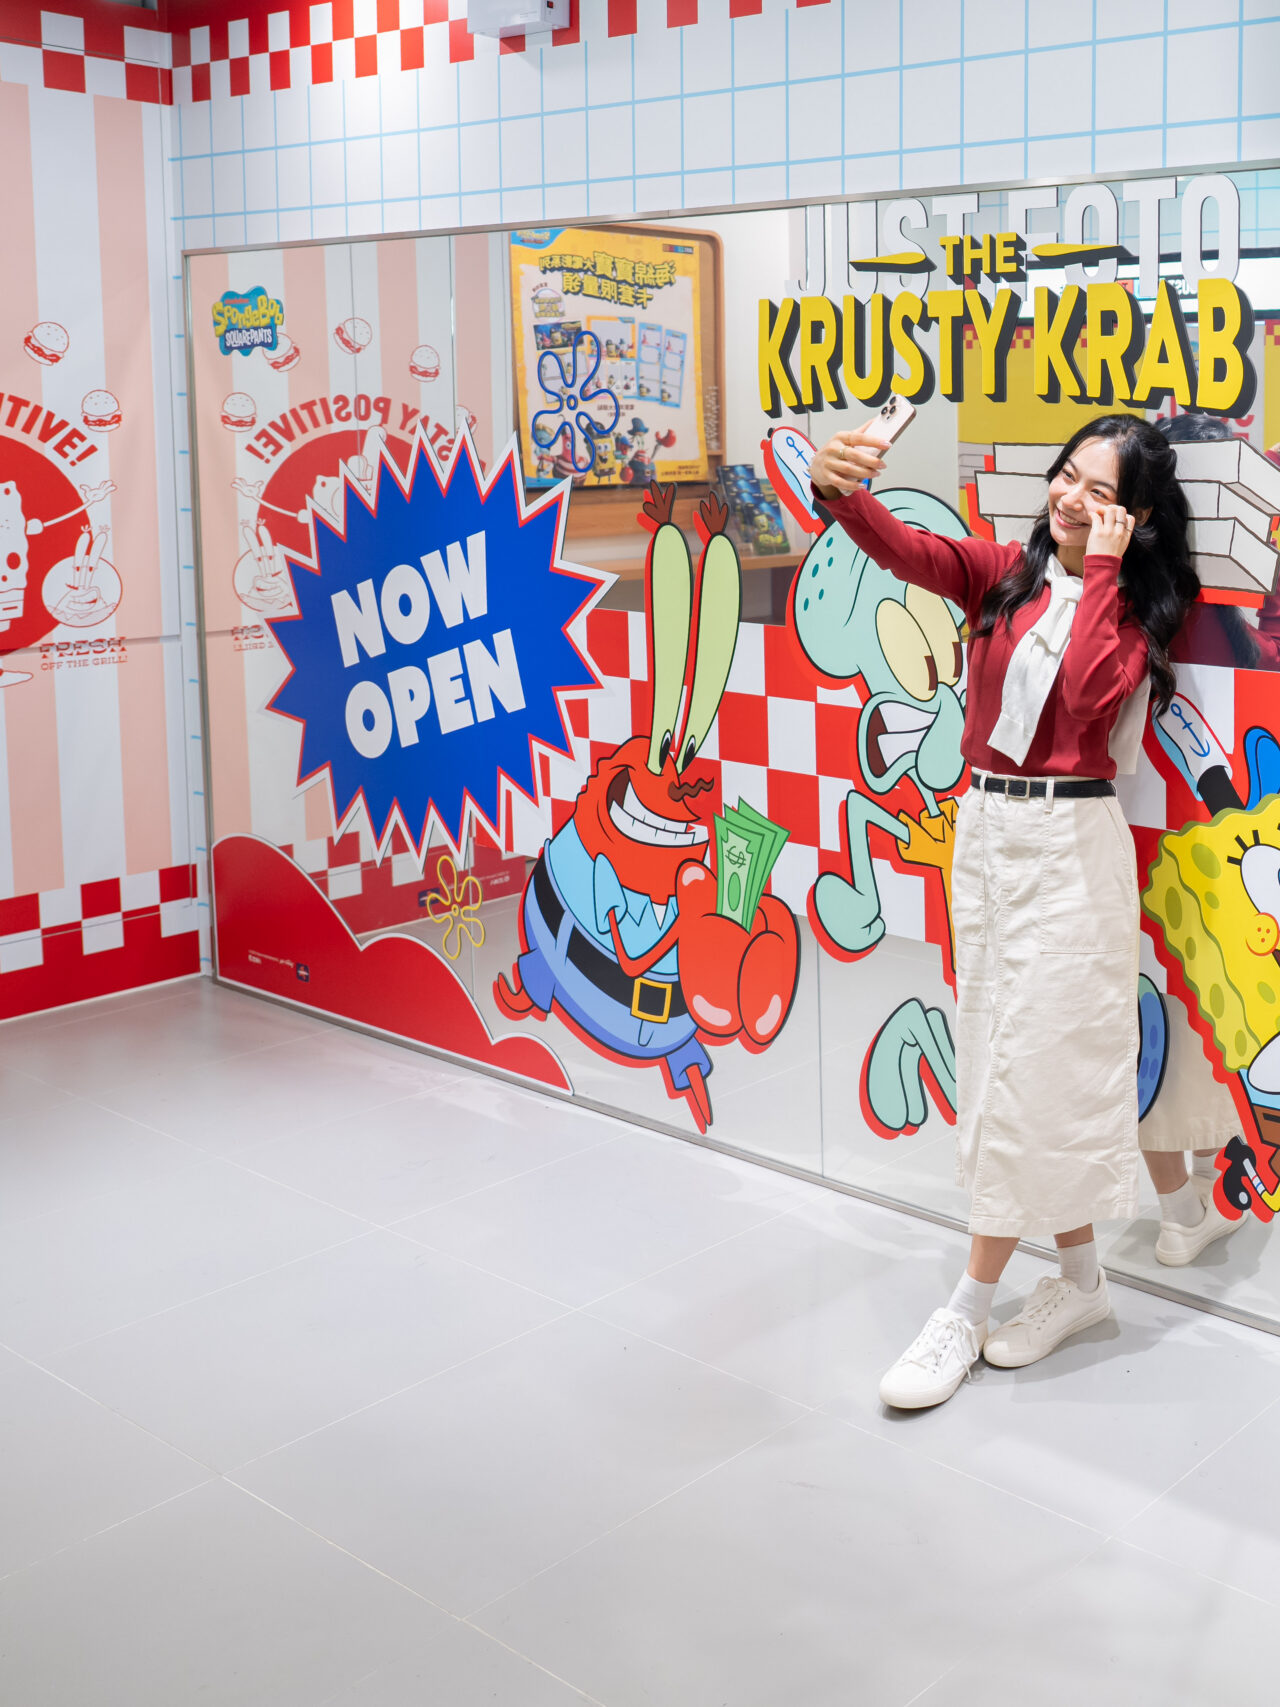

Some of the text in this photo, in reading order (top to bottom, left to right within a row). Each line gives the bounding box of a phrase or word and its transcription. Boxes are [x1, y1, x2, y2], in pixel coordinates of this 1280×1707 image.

[784, 173, 1240, 303] JUST FOTO
[939, 231, 1022, 284] THE
[225, 327, 272, 347] SQUAREPANTS
[758, 289, 1021, 418] KRUSTY
[1034, 277, 1257, 418] KRAB
[330, 530, 488, 668] NOW
[40, 636, 128, 659] FRESH
[40, 661, 64, 671] OFF
[66, 659, 90, 669] THE
[345, 628, 526, 759] OPEN
